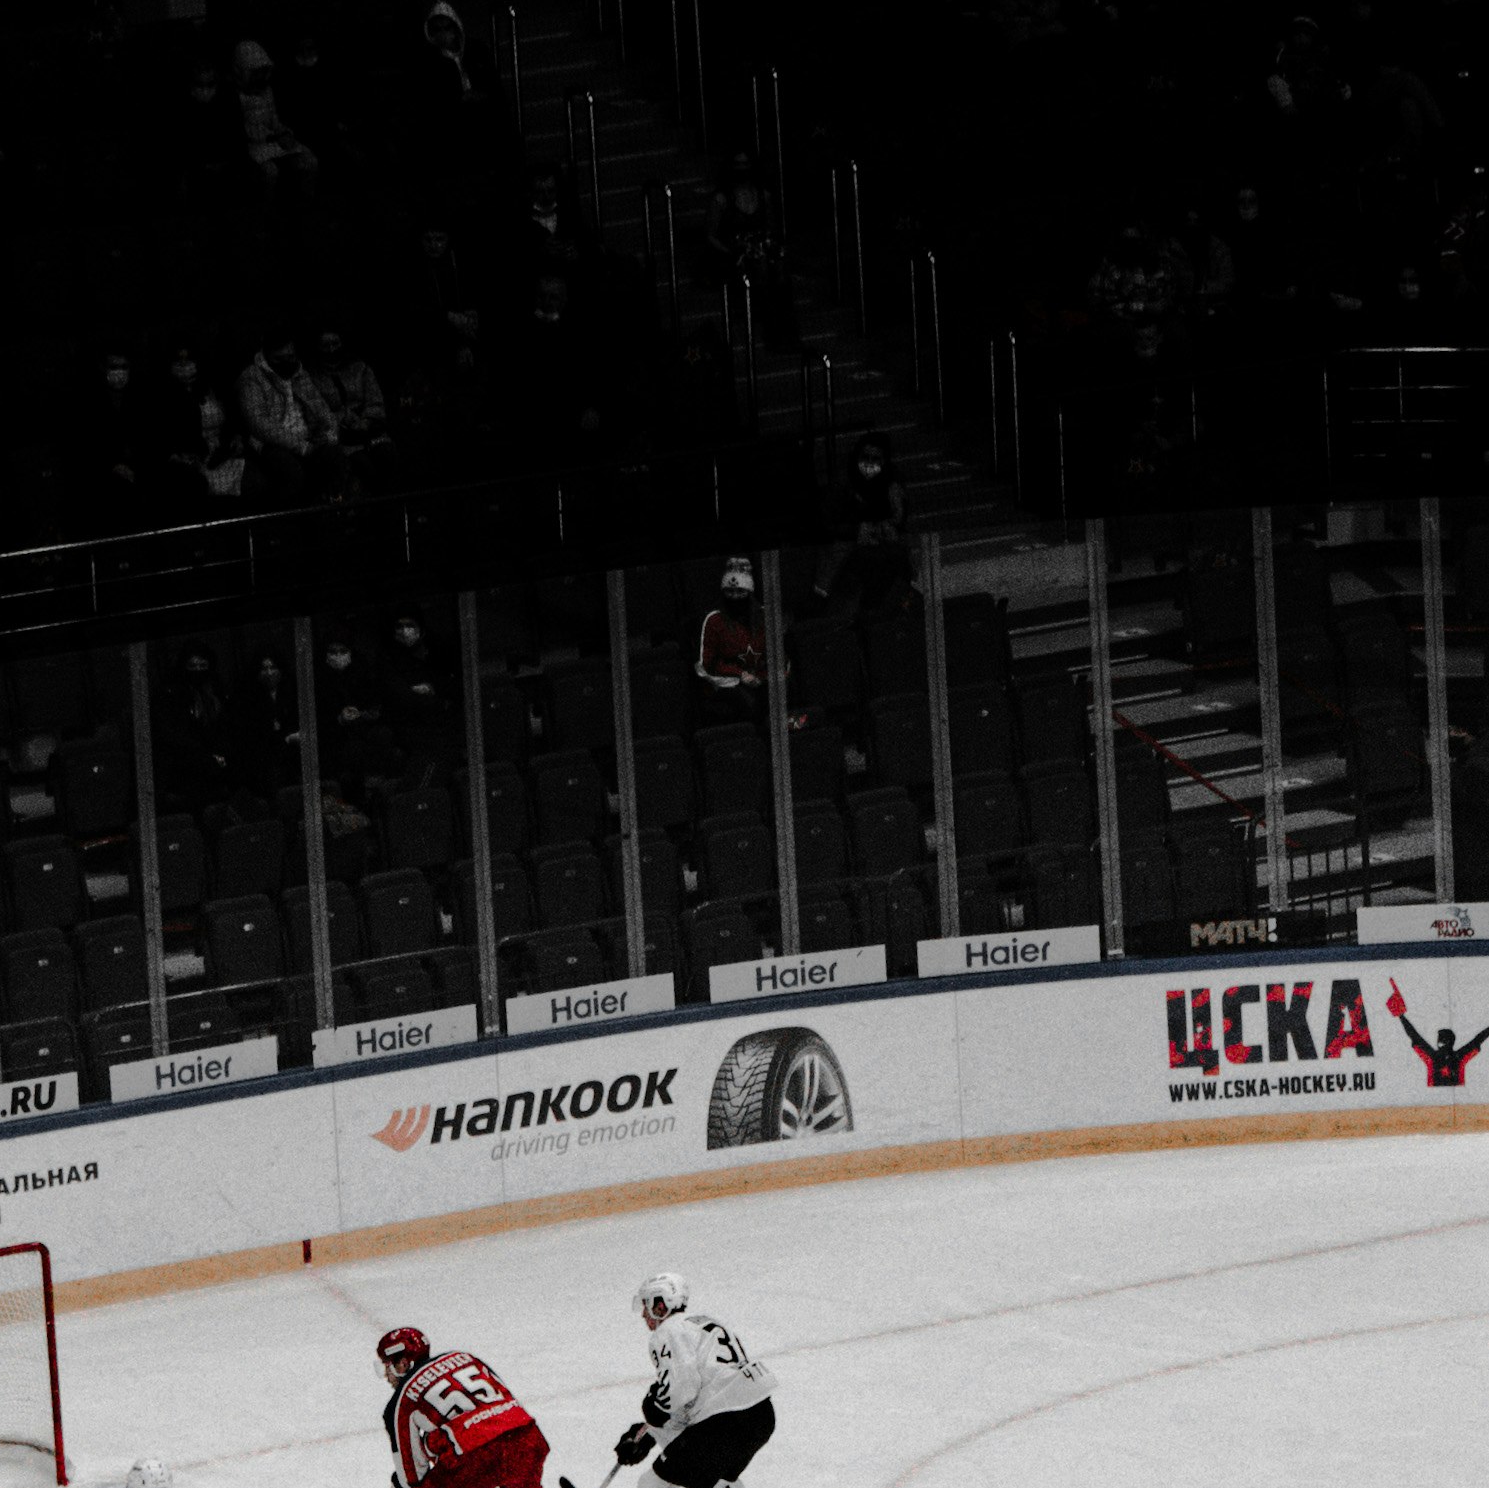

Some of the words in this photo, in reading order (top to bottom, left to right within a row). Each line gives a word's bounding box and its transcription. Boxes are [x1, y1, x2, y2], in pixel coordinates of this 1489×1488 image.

[1190, 917, 1277, 947] МАТЧ!
[965, 938, 1050, 968] Haier
[755, 960, 838, 992] Haier
[549, 991, 628, 1024] Haier
[355, 1022, 433, 1056] Haier
[1166, 979, 1375, 1076] ЦСКА
[154, 1056, 233, 1090] Haier
[1169, 1072, 1376, 1103] WWW.CSKA-HOCKEY.RU
[490, 1129, 571, 1162] driving
[577, 1114, 677, 1147] emotion
[424, 1365, 504, 1420] 55
